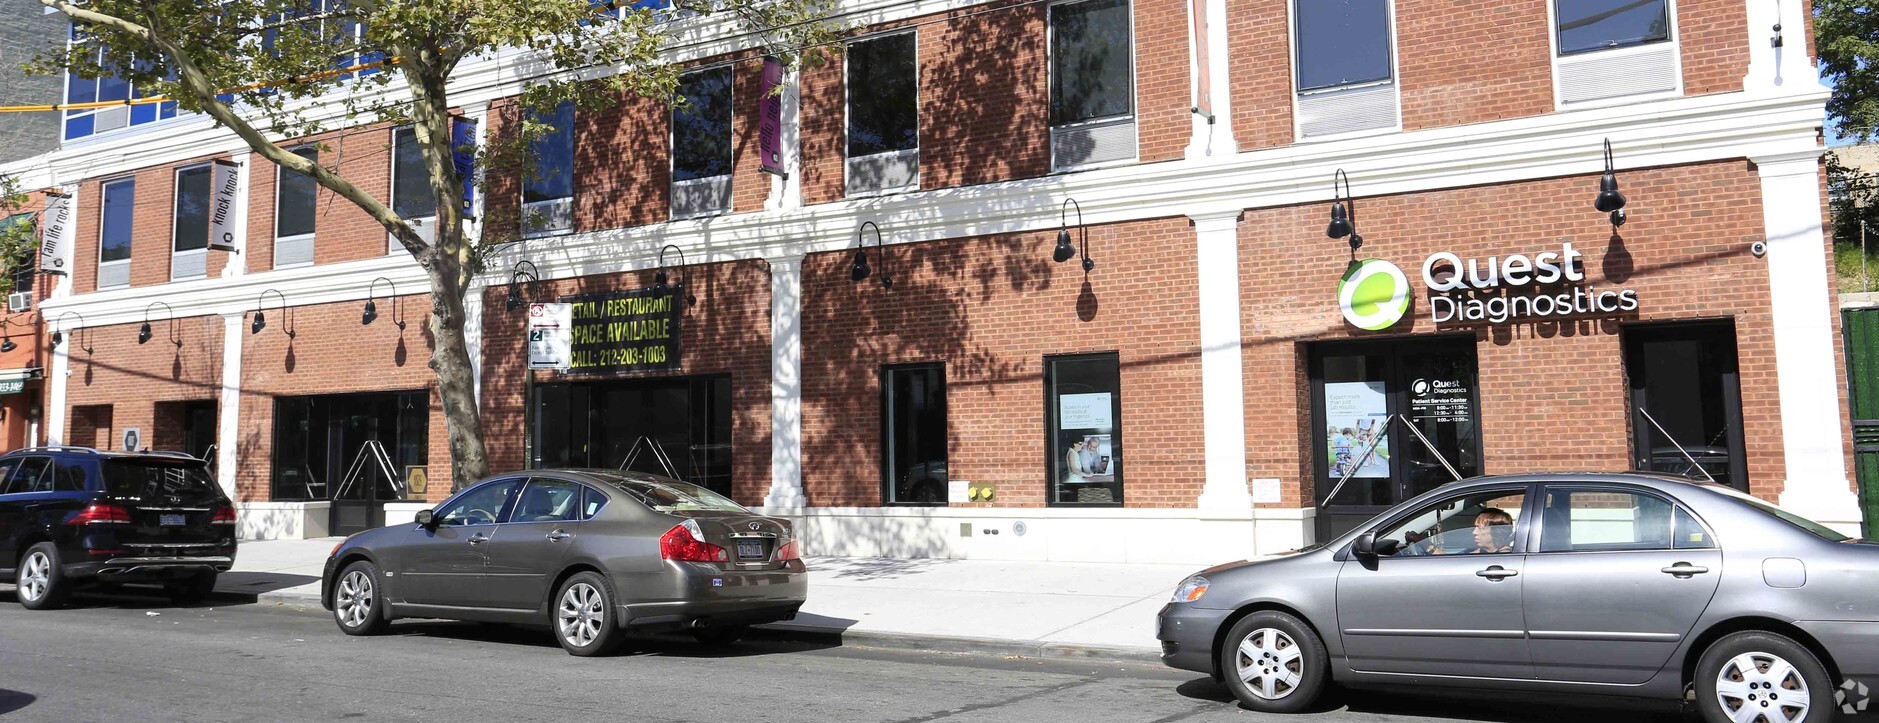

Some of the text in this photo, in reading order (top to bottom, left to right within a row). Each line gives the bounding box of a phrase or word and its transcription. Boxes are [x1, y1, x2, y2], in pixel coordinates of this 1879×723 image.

[212, 168, 238, 226] knock knock
[45, 224, 63, 240] life
[44, 239, 57, 254] am
[1421, 242, 1584, 292] Quest
[571, 301, 598, 320] ETAIL
[607, 294, 673, 317] RESTAURANT
[1430, 285, 1639, 323] Diagnostics
[571, 323, 604, 345] SPACE
[607, 317, 670, 343] AVAILABLE
[571, 350, 597, 368] CALL:
[600, 345, 666, 367] 212-203-1003
[1432, 379, 1460, 388] Quest
